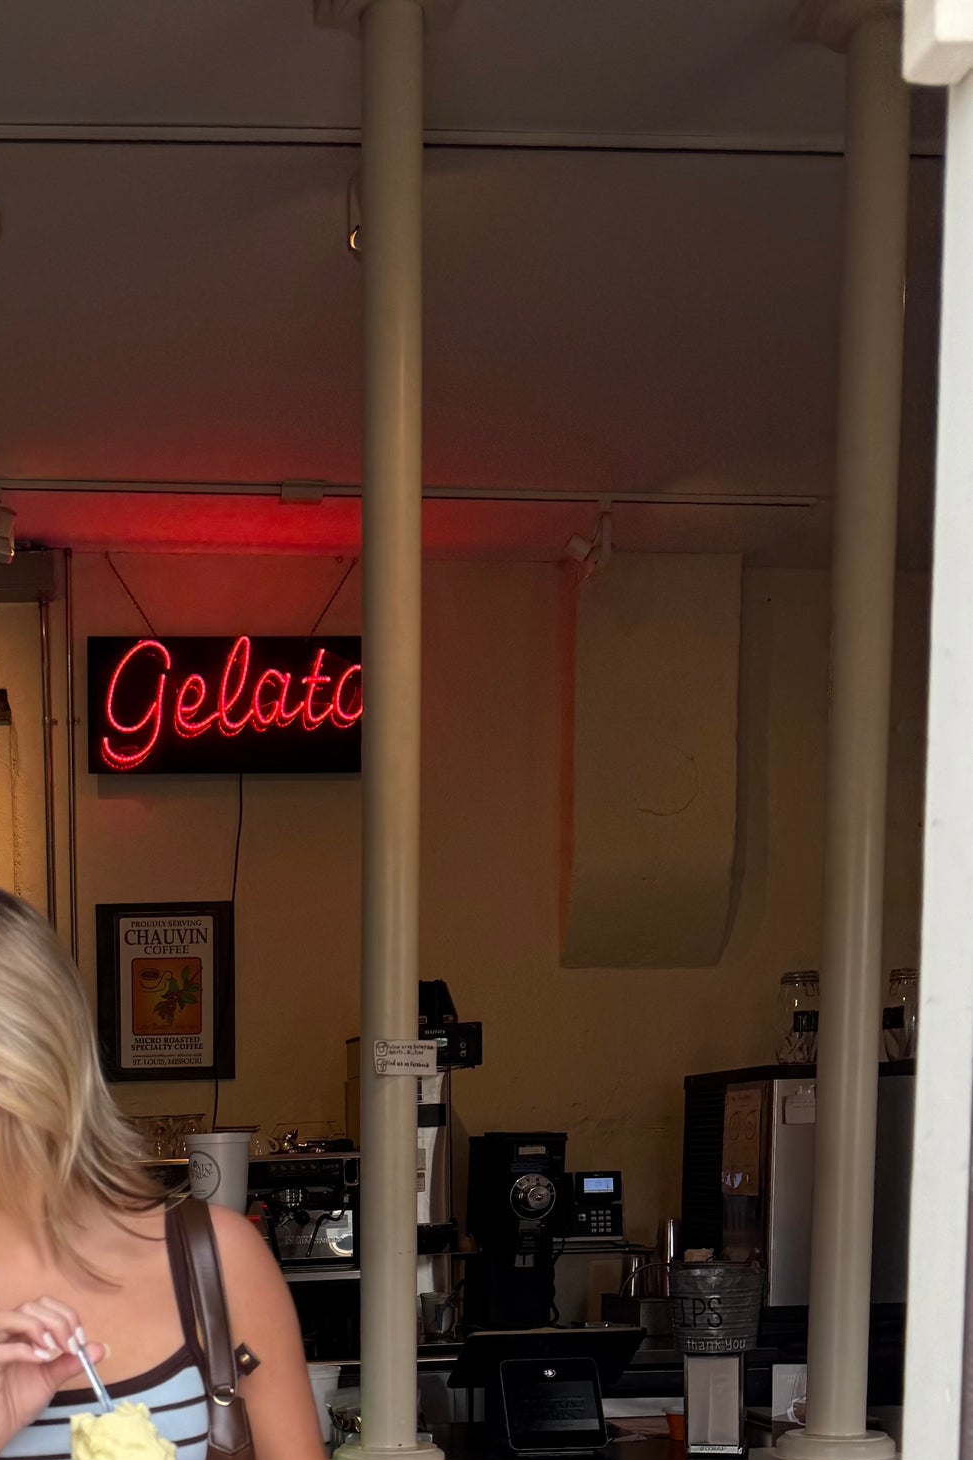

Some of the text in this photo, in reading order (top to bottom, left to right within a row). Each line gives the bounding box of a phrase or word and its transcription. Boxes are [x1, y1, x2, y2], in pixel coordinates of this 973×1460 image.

[101, 636, 362, 768] Gelato
[168, 919, 202, 927] SERVING
[124, 927, 208, 946] CHAUVIN
[144, 945, 190, 955] COFFEE
[163, 1036, 200, 1044] ROASTED
[673, 1297, 723, 1328] IPS
[686, 1336, 722, 1351] thank
